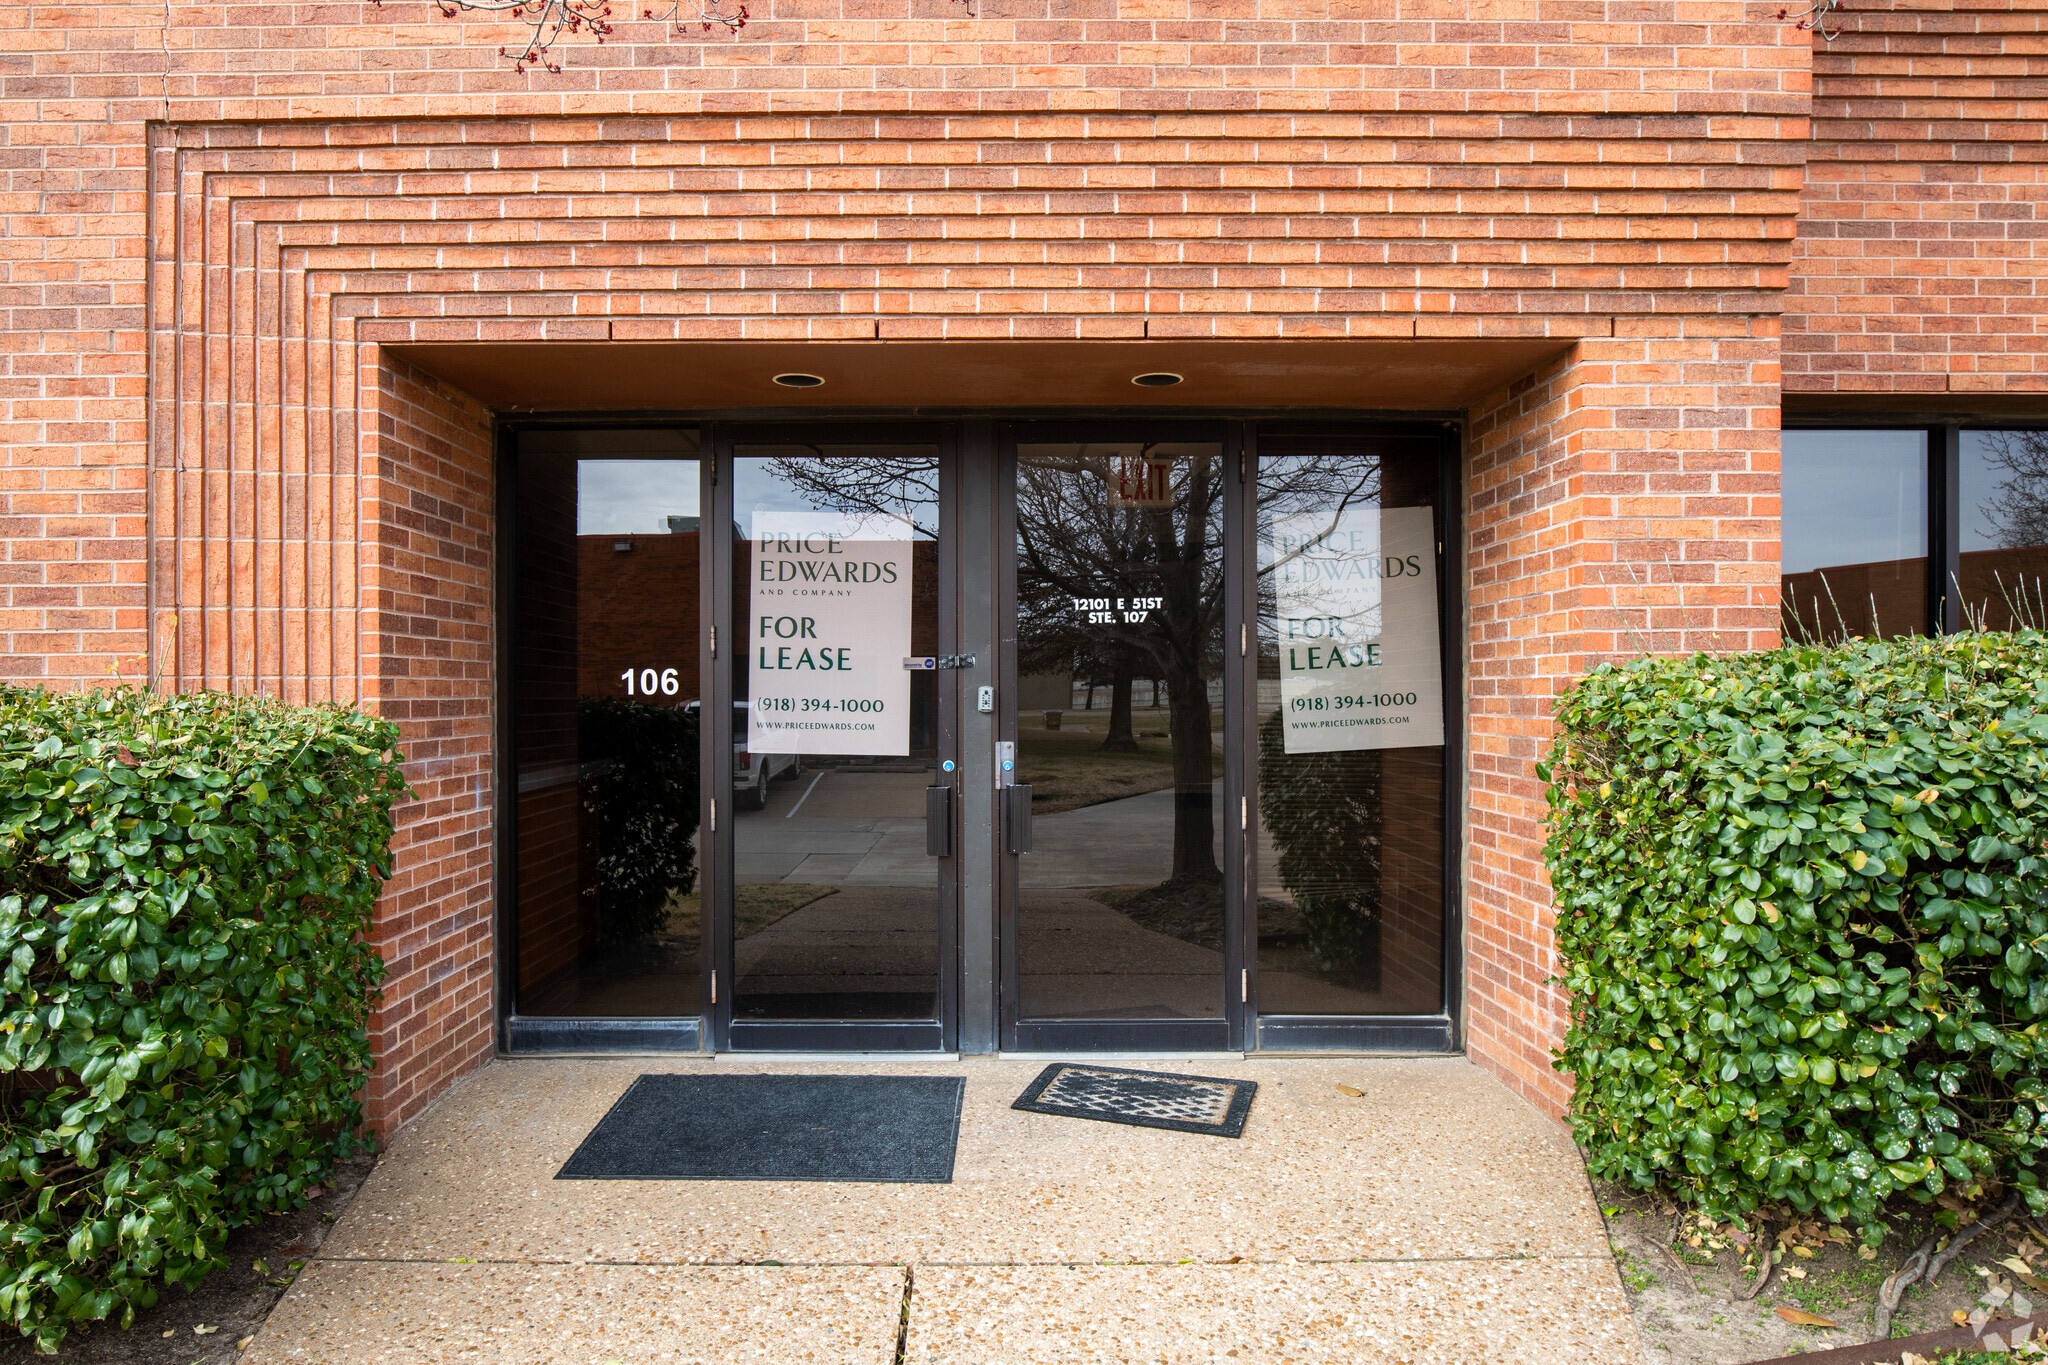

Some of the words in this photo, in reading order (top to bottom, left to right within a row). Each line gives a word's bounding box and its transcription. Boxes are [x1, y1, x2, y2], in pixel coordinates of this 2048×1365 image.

[1120, 464, 1167, 501] EXIT
[760, 531, 843, 554] PRICE
[1282, 530, 1365, 555] PRICE
[759, 560, 898, 583] EDWARDS
[1284, 555, 1421, 584] EDWARDS
[759, 588, 784, 596] AND
[792, 588, 852, 597] COMPANY
[1073, 598, 1110, 611] 12101
[1116, 598, 1125, 610] E
[1132, 596, 1163, 610] 51ST
[760, 616, 817, 639] FOR
[1088, 611, 1117, 624] STE.
[1123, 611, 1148, 624] 107
[1288, 616, 1345, 639] FOR
[759, 646, 852, 671] LEASE
[1290, 643, 1383, 671] LEASE
[621, 667, 679, 696] 106
[757, 696, 796, 713] (918)
[800, 698, 885, 713] 394-1000
[1291, 696, 1329, 713] (918)
[1334, 692, 1417, 709] 394-1000
[756, 721, 875, 731] WWW.PRICEEDWARDS.COM
[1291, 716, 1410, 730] WWW.PRICEEDWARDS.COM
